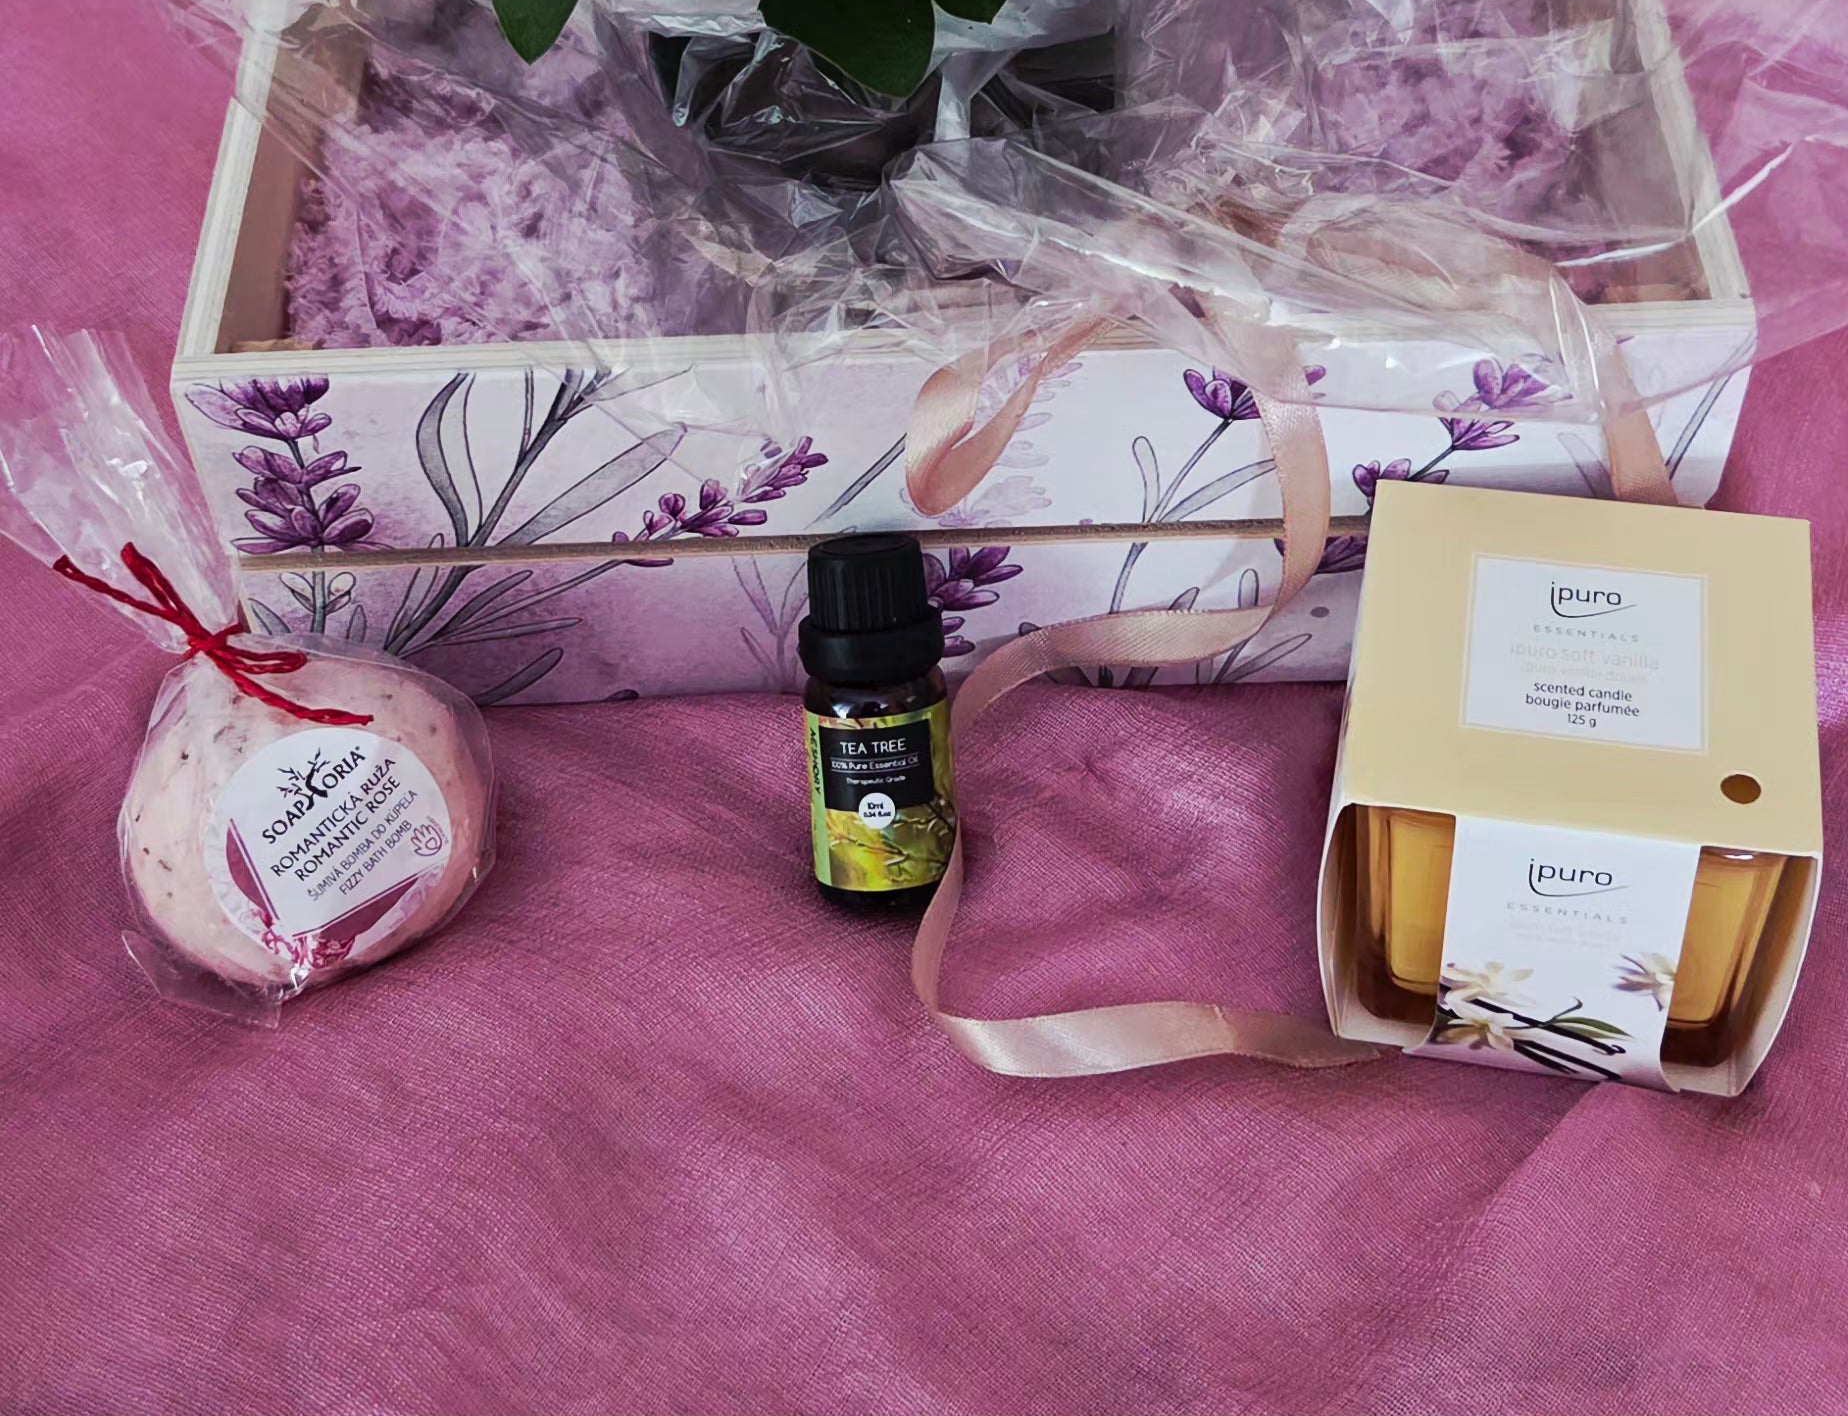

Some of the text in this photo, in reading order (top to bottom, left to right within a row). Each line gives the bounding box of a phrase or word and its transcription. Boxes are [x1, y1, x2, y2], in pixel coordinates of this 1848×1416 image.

[1550, 581, 1633, 618] ipuro
[1533, 624, 1640, 643] ESSENTIALS
[1560, 645, 1595, 665] soft
[1533, 681, 1633, 702] scented candle
[1525, 693, 1640, 718] bougie parfumée
[1567, 713, 1597, 728] 125 g
[839, 737, 907, 756] TEA TREE
[848, 761, 868, 771] Pure
[869, 758, 906, 770] Essential
[885, 774, 907, 784] Grade
[867, 801, 884, 811] 10ml
[270, 791, 363, 878] ROMANTICKÁ
[360, 757, 396, 795] RUŽA
[294, 811, 369, 882] ROMANTIC
[366, 775, 401, 814] ROSE
[339, 866, 366, 896] FIZZY
[363, 843, 389, 873] BATH
[385, 819, 413, 850] BOMB
[340, 838, 375, 874] BOMBA
[371, 823, 388, 841] DO
[1528, 858, 1624, 897] ipuro
[1506, 902, 1629, 925] ESSENTIALS
